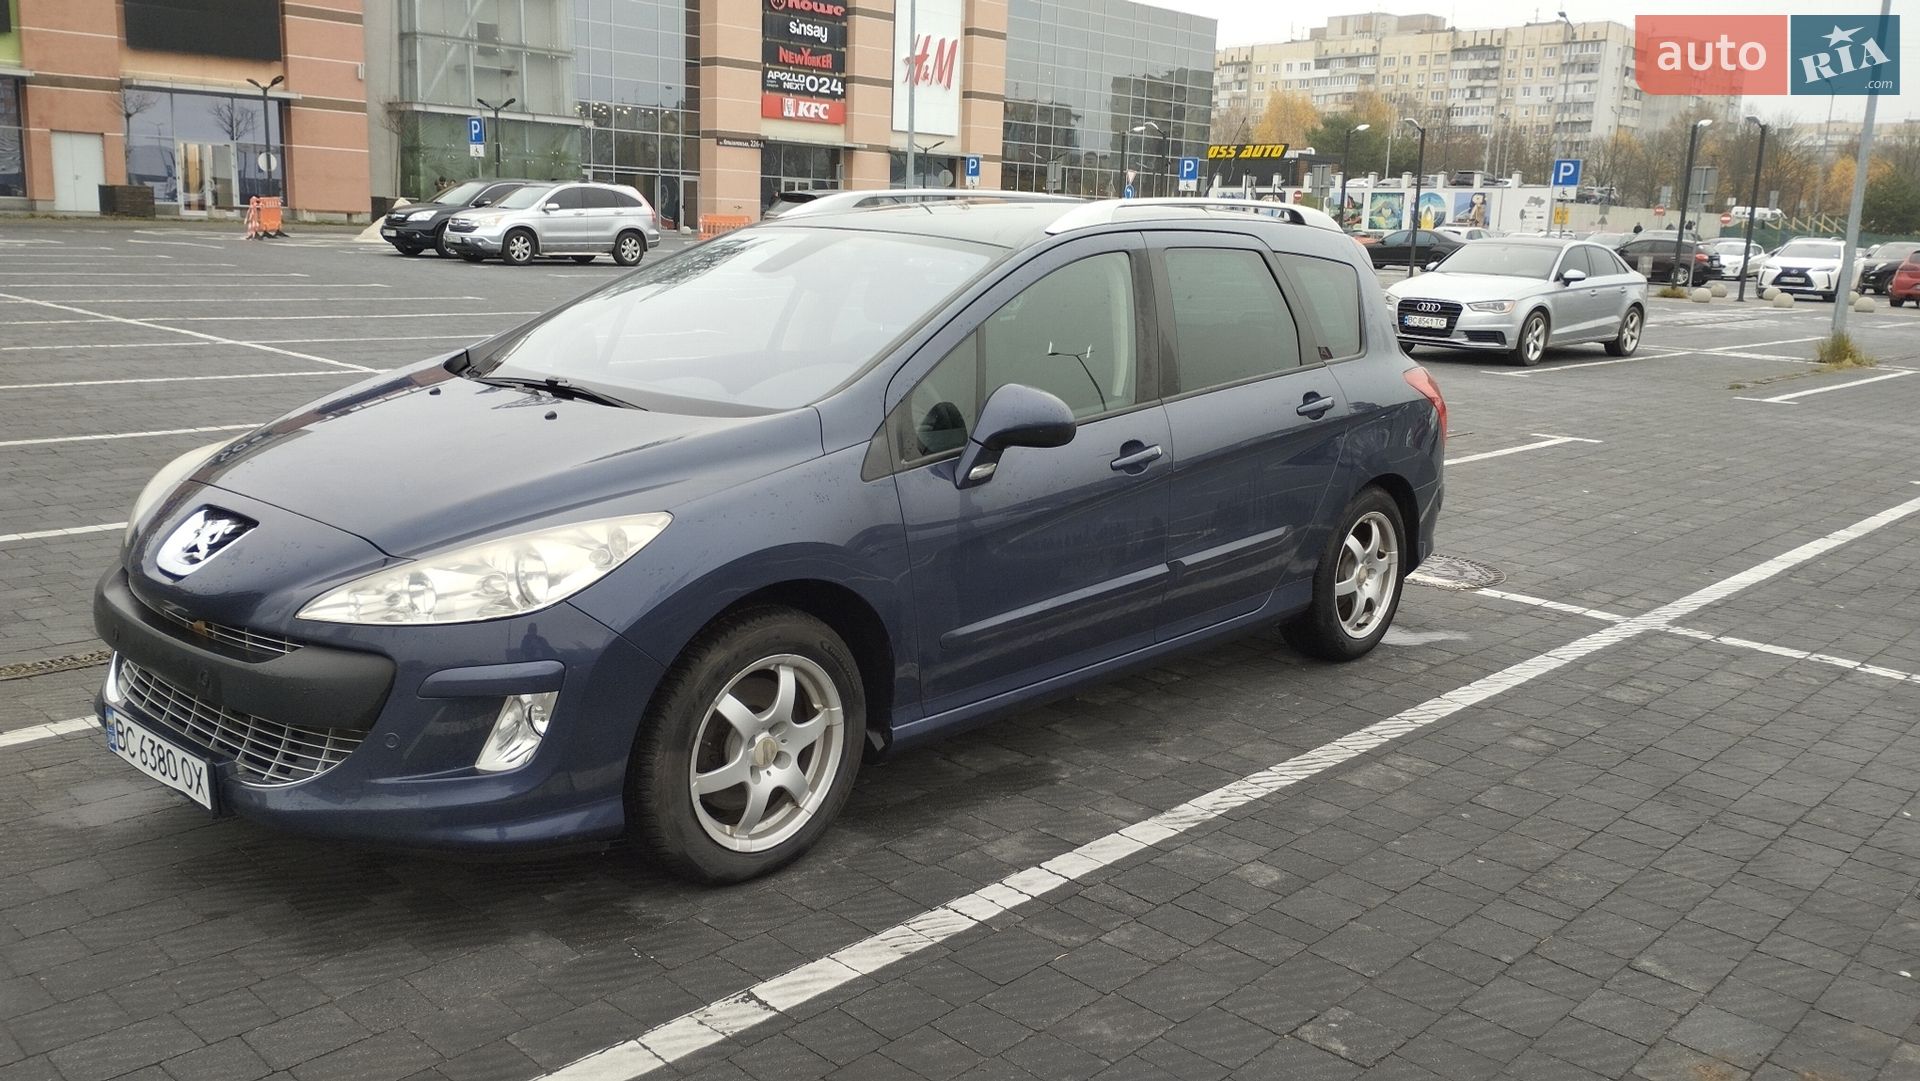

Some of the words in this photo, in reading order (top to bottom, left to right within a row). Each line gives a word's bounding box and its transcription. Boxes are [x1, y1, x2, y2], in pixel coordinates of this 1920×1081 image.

[789, 18, 828, 43] sinsay
[902, 34, 958, 90] H&M
[767, 70, 805, 83] APOLLO
[783, 81, 805, 91] NEXT
[797, 101, 830, 119] KFC
[471, 120, 480, 140] P
[1208, 145, 1237, 158] OSS
[1239, 145, 1285, 158] AUTO
[969, 158, 977, 174] P
[1183, 160, 1194, 177] P
[1558, 162, 1574, 183] P
[115, 718, 136, 758] BC
[140, 735, 178, 781] 6380
[181, 757, 207, 801] OX
